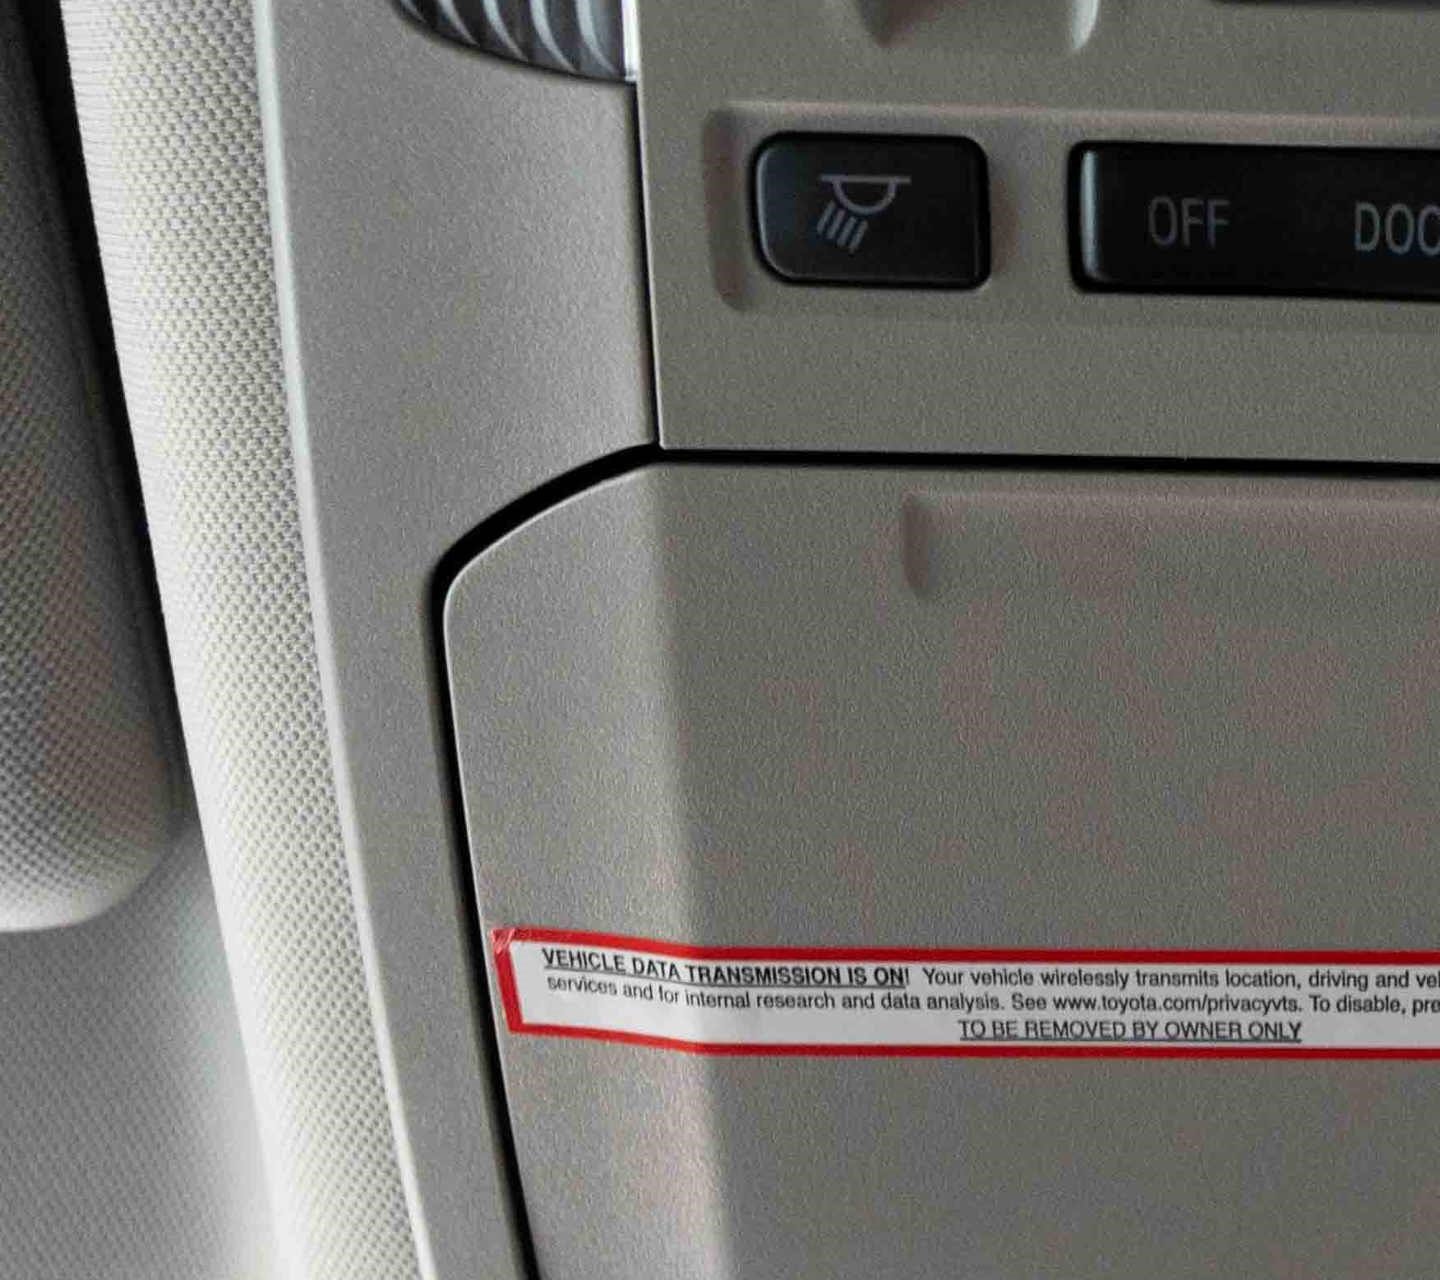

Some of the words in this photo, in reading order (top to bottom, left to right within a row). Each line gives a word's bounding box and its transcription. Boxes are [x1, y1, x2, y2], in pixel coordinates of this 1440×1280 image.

[1147, 195, 1232, 247] OFF
[541, 947, 628, 974] VEHICLE
[632, 956, 681, 983] DATA
[685, 963, 843, 988] TRANSMISSION
[846, 966, 868, 987] IS
[872, 966, 910, 988] ON!
[922, 967, 963, 987] Your
[970, 968, 1034, 987] vehicle
[1040, 968, 1129, 991] wirelessly
[1135, 969, 1220, 989] transmits
[1225, 969, 1302, 991] location,
[1308, 970, 1369, 992] driving
[1375, 970, 1410, 989] and
[547, 975, 618, 997] services
[623, 982, 654, 1001] and
[659, 986, 680, 1005] for
[685, 989, 751, 1010] internal
[756, 990, 836, 1010] research
[841, 992, 876, 1011] and
[880, 993, 921, 1011] data
[926, 993, 1006, 1015] analysis.
[1011, 993, 1048, 1011] See
[1052, 993, 1304, 1017] www.toyota.com/privacyvts.
[1309, 994, 1331, 1013] To
[1336, 994, 1407, 1016] disable,
[959, 1019, 986, 1040] TO
[991, 1020, 1019, 1040] BE
[1024, 1020, 1126, 1041] REMOVED
[1132, 1020, 1159, 1041] BY
[1164, 1021, 1243, 1042] OWNER
[1248, 1022, 1303, 1042] ONLY
